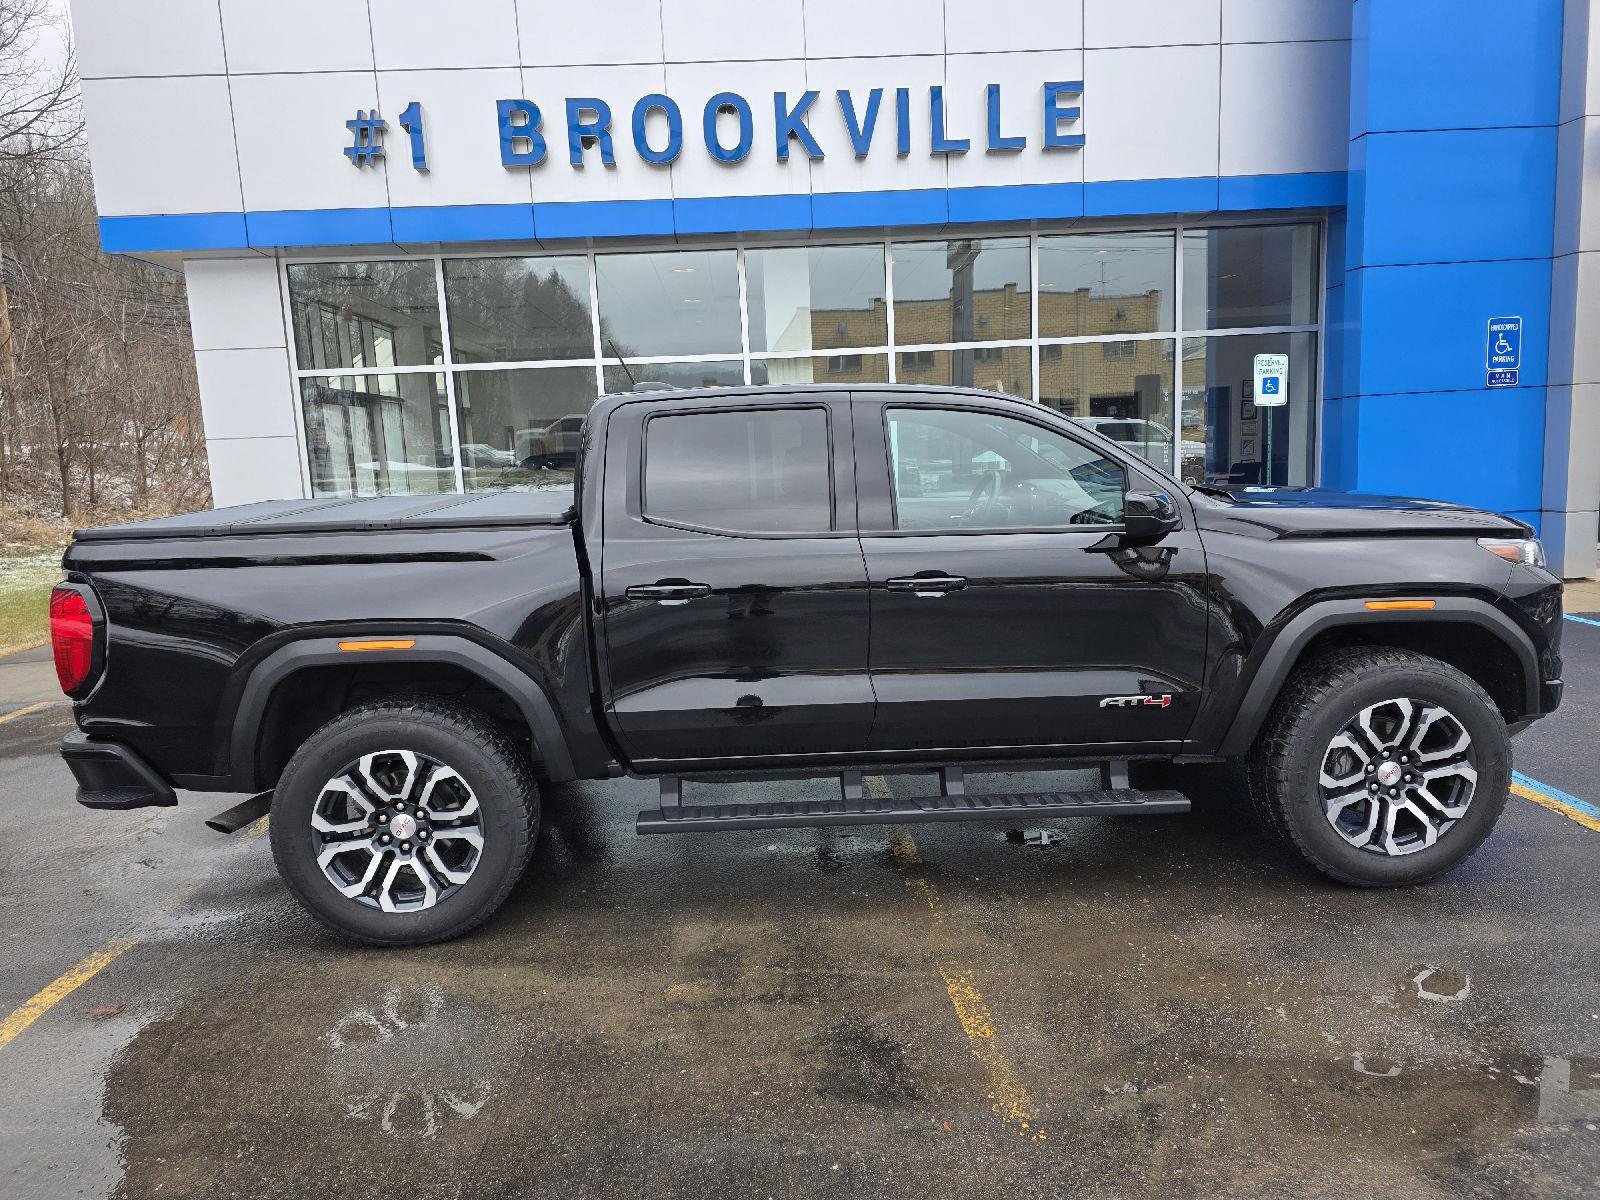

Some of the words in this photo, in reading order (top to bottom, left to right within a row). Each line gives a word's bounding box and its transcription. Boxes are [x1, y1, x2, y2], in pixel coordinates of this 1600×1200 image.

[344, 100, 430, 174] #1
[496, 80, 1086, 170] BROOKVILLE
[1258, 367, 1284, 375] PARKING
[1099, 694, 1172, 709] AT4
